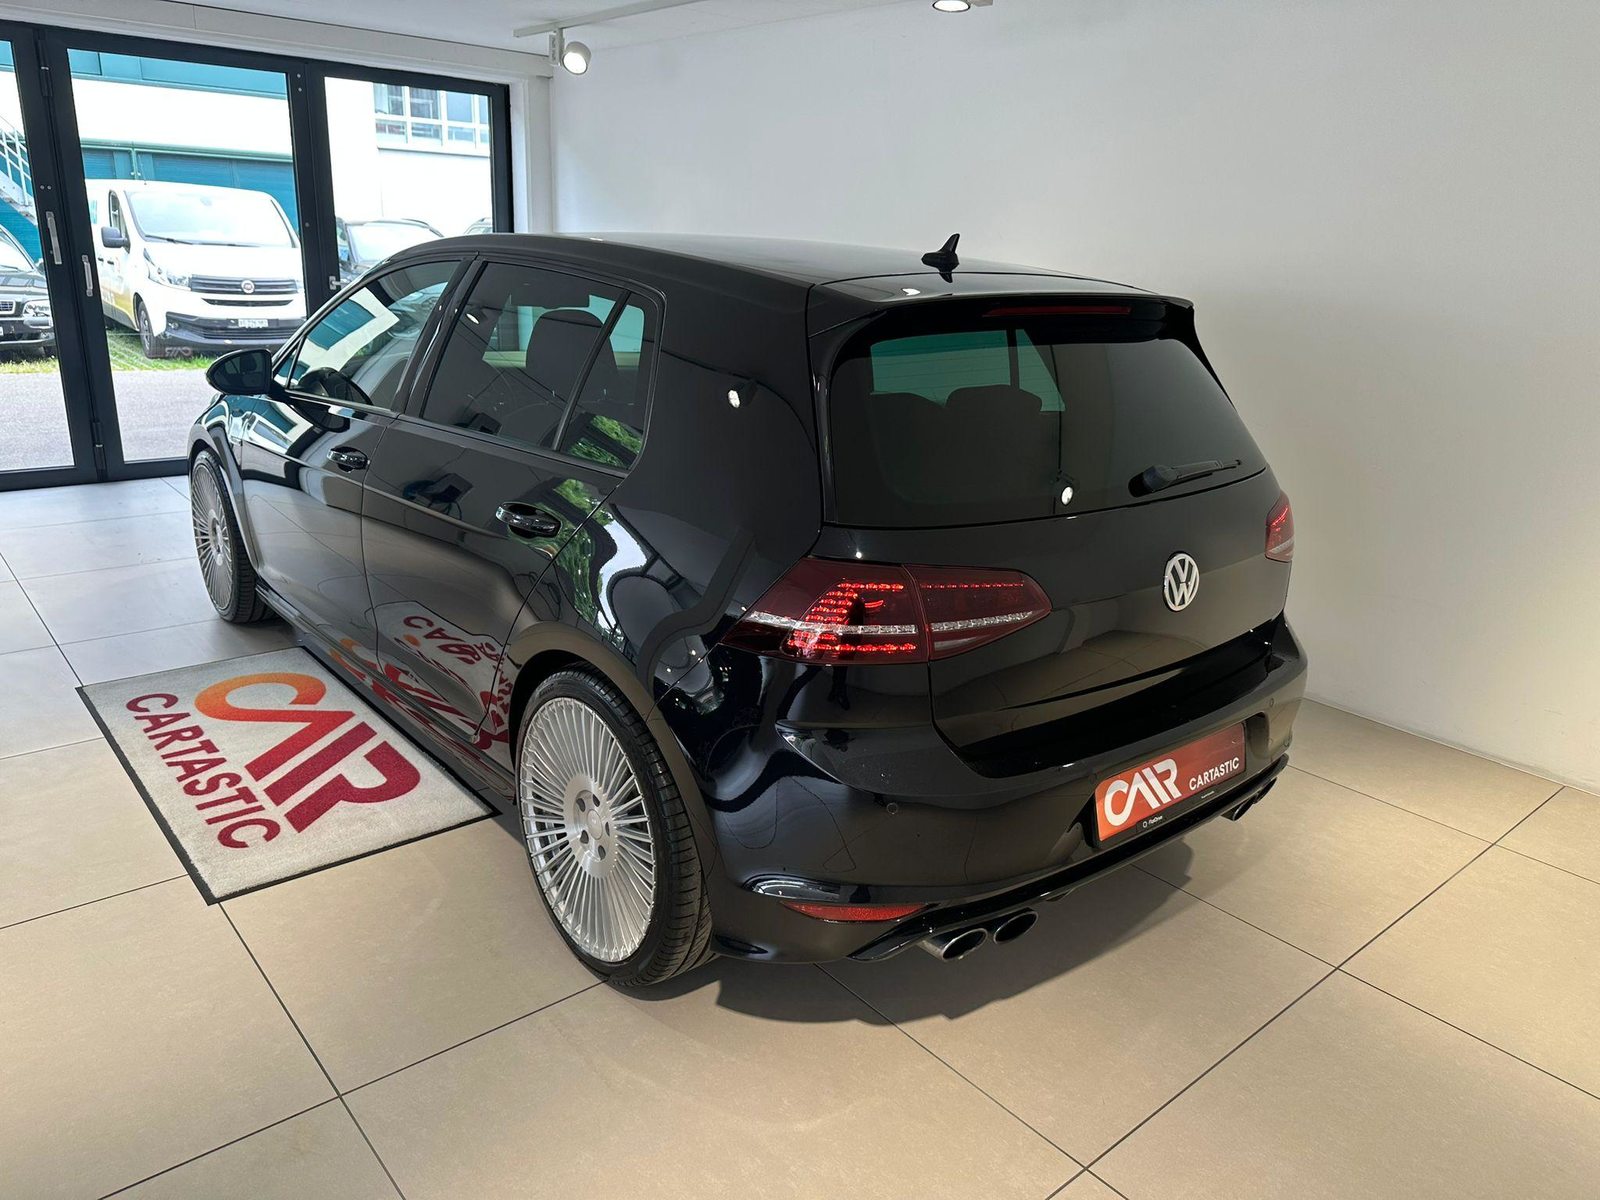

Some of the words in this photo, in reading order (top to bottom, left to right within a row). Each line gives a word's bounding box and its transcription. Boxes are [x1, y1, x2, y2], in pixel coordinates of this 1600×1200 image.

[1165, 554, 1199, 611] VW
[125, 692, 281, 848] CARTASTIC
[1104, 758, 1182, 826] CAR
[1189, 757, 1240, 791] CARTASTIC
